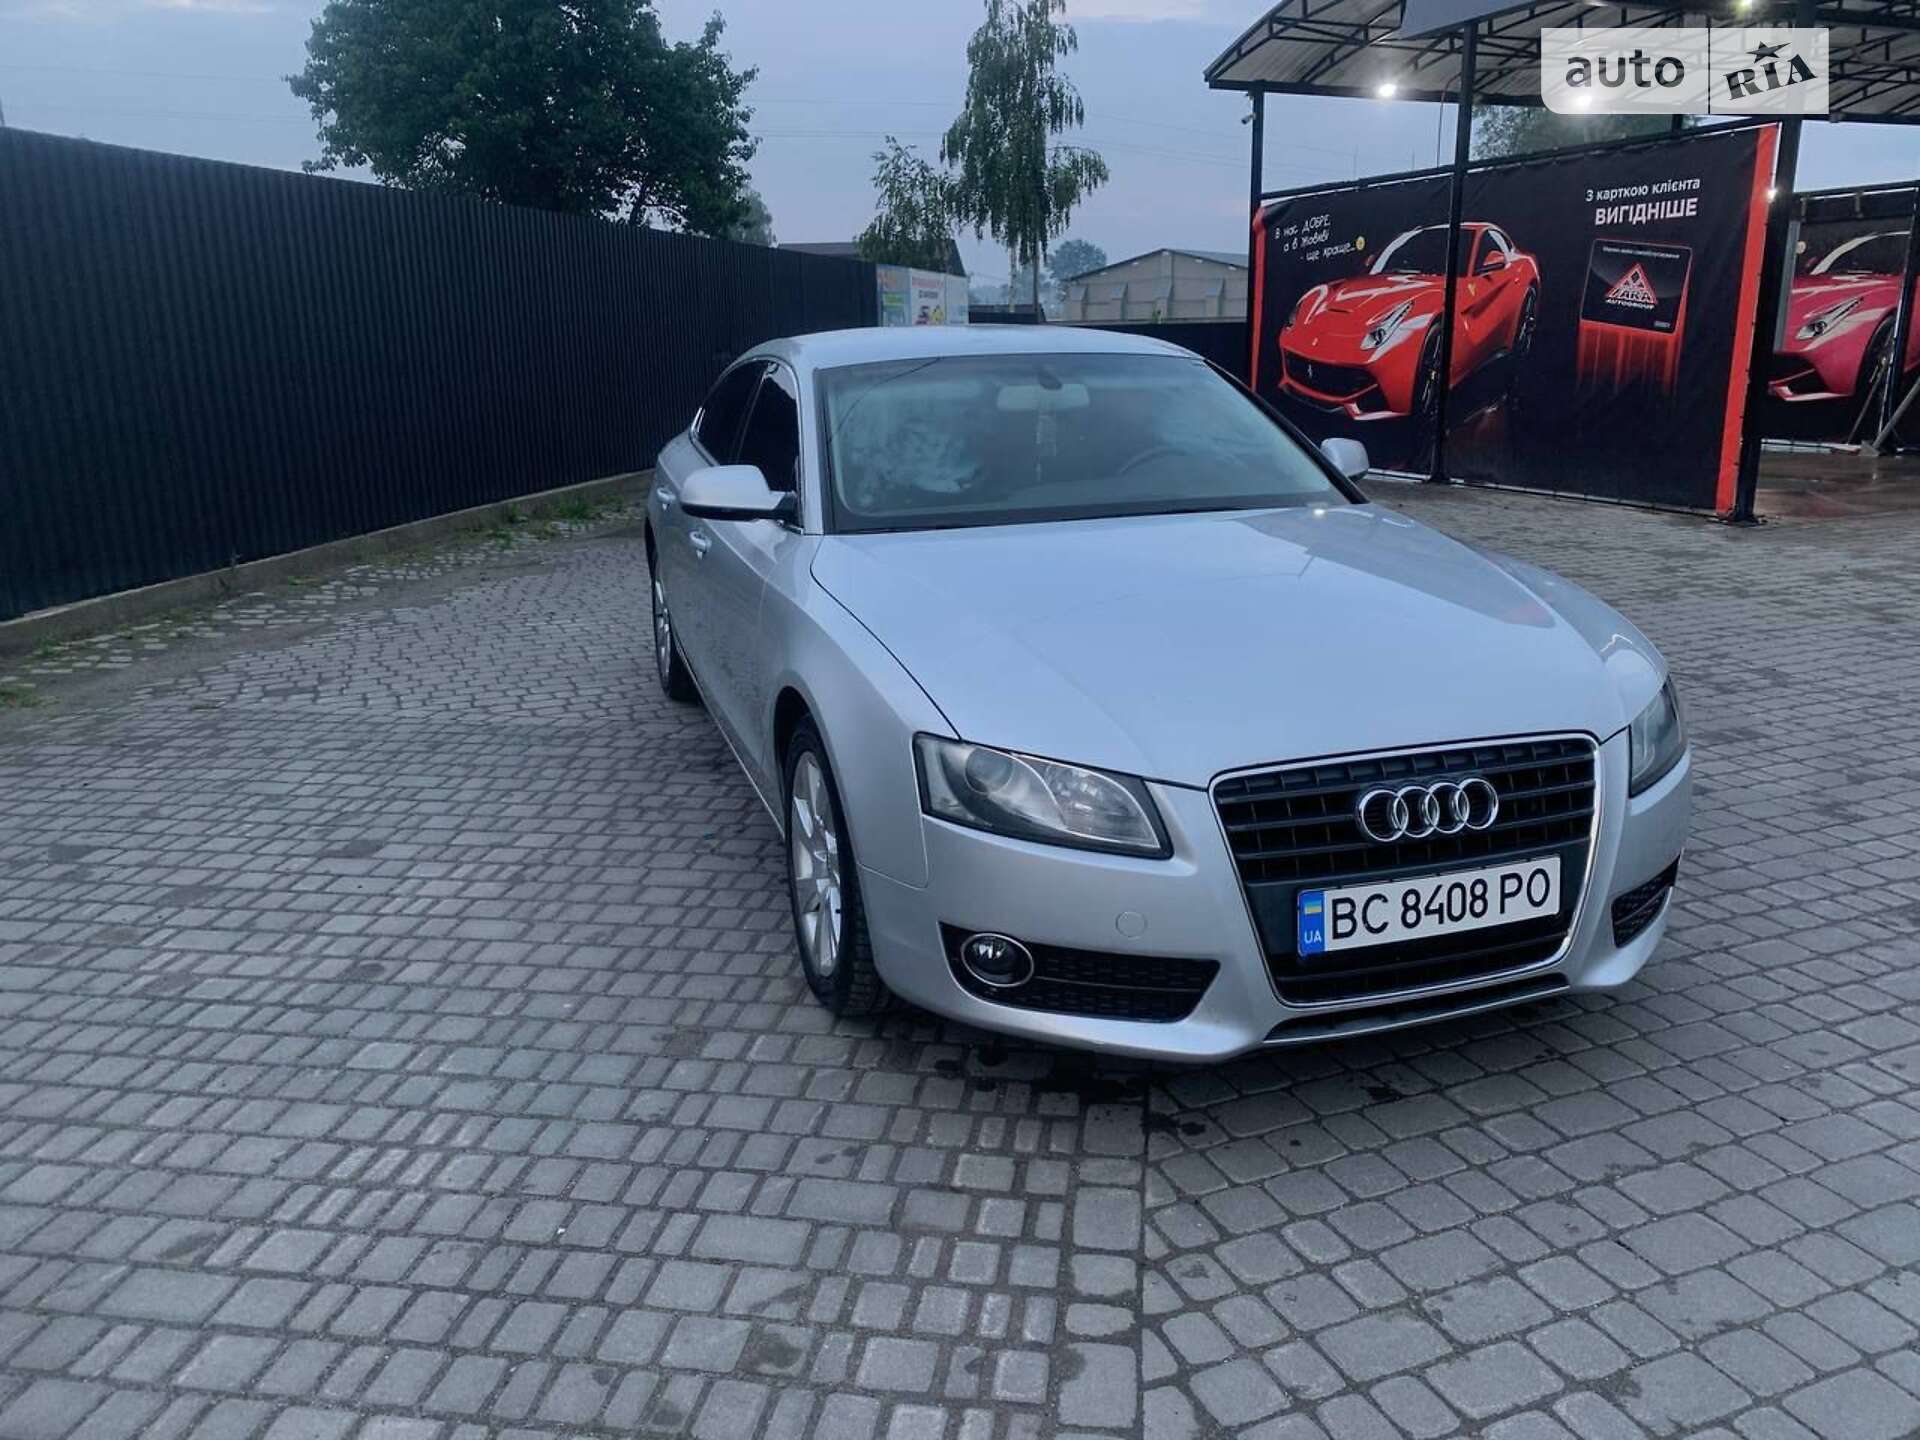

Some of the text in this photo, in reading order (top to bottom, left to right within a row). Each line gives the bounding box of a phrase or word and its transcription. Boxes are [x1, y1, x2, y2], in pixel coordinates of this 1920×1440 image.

[1585, 179, 1701, 202] З карткою клієнта
[1595, 198, 1698, 225] ВИГІДНІШЕ
[1331, 868, 1550, 940] BC 8408 PO
[1304, 930, 1322, 944] UA
